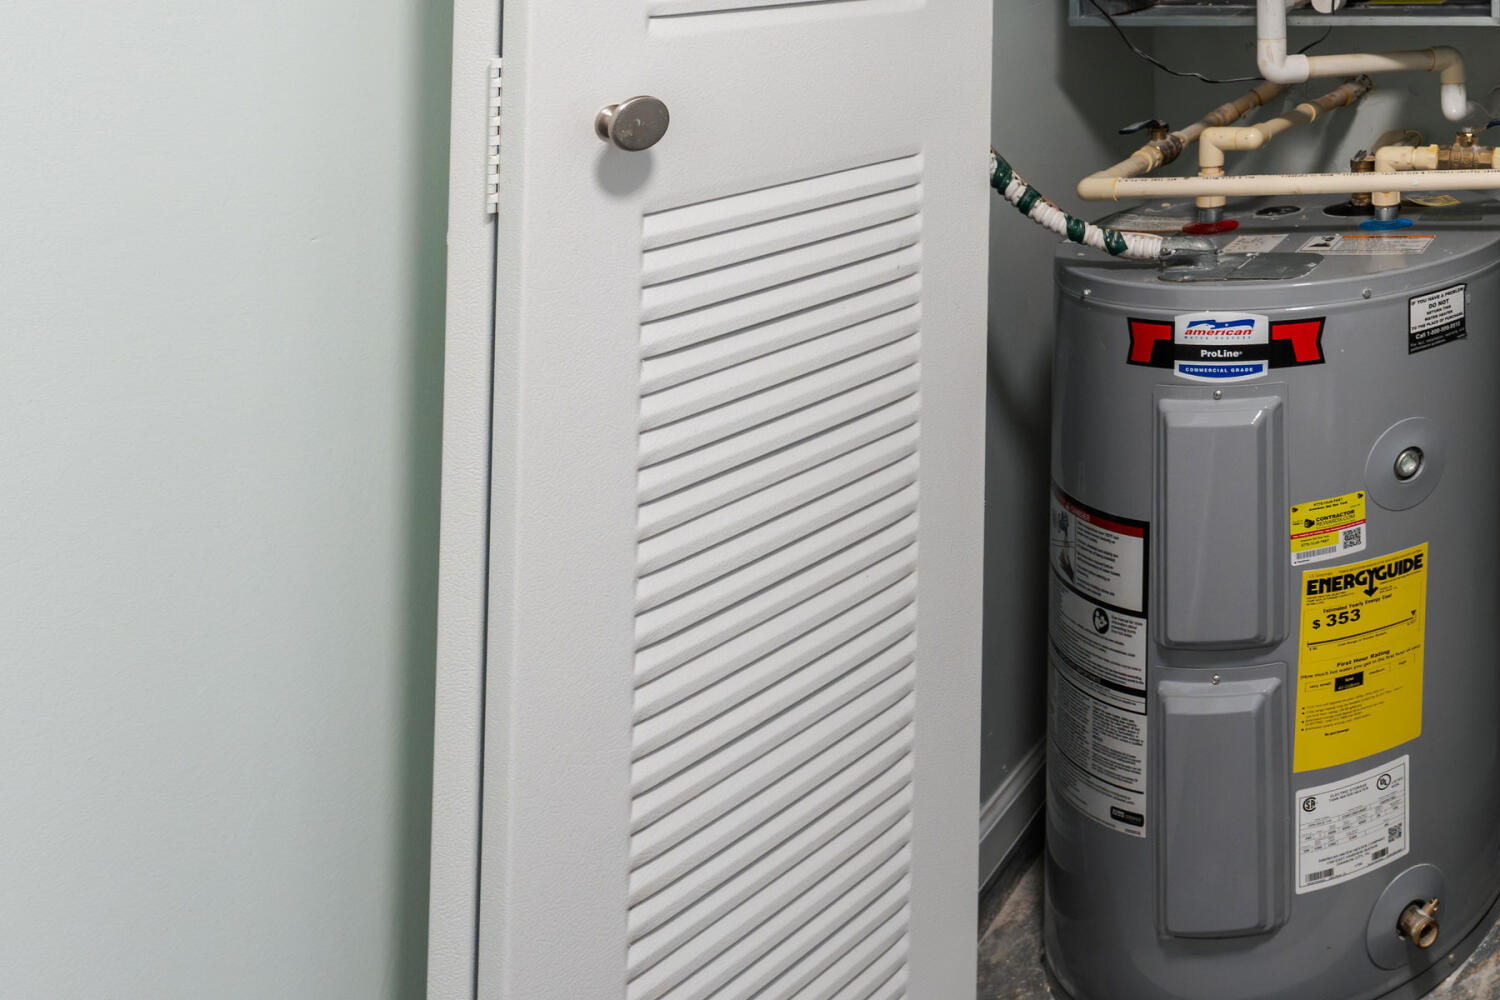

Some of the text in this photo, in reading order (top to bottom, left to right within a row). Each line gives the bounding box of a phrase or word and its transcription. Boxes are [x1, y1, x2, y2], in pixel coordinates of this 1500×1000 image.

[1316, 510, 1355, 521] CONTRACTOR
[1306, 553, 1424, 597] ENERGYGUIDE
[1323, 605, 1347, 614] Estimated
[1312, 609, 1360, 630] $ 353
[1370, 650, 1390, 659] Rating
